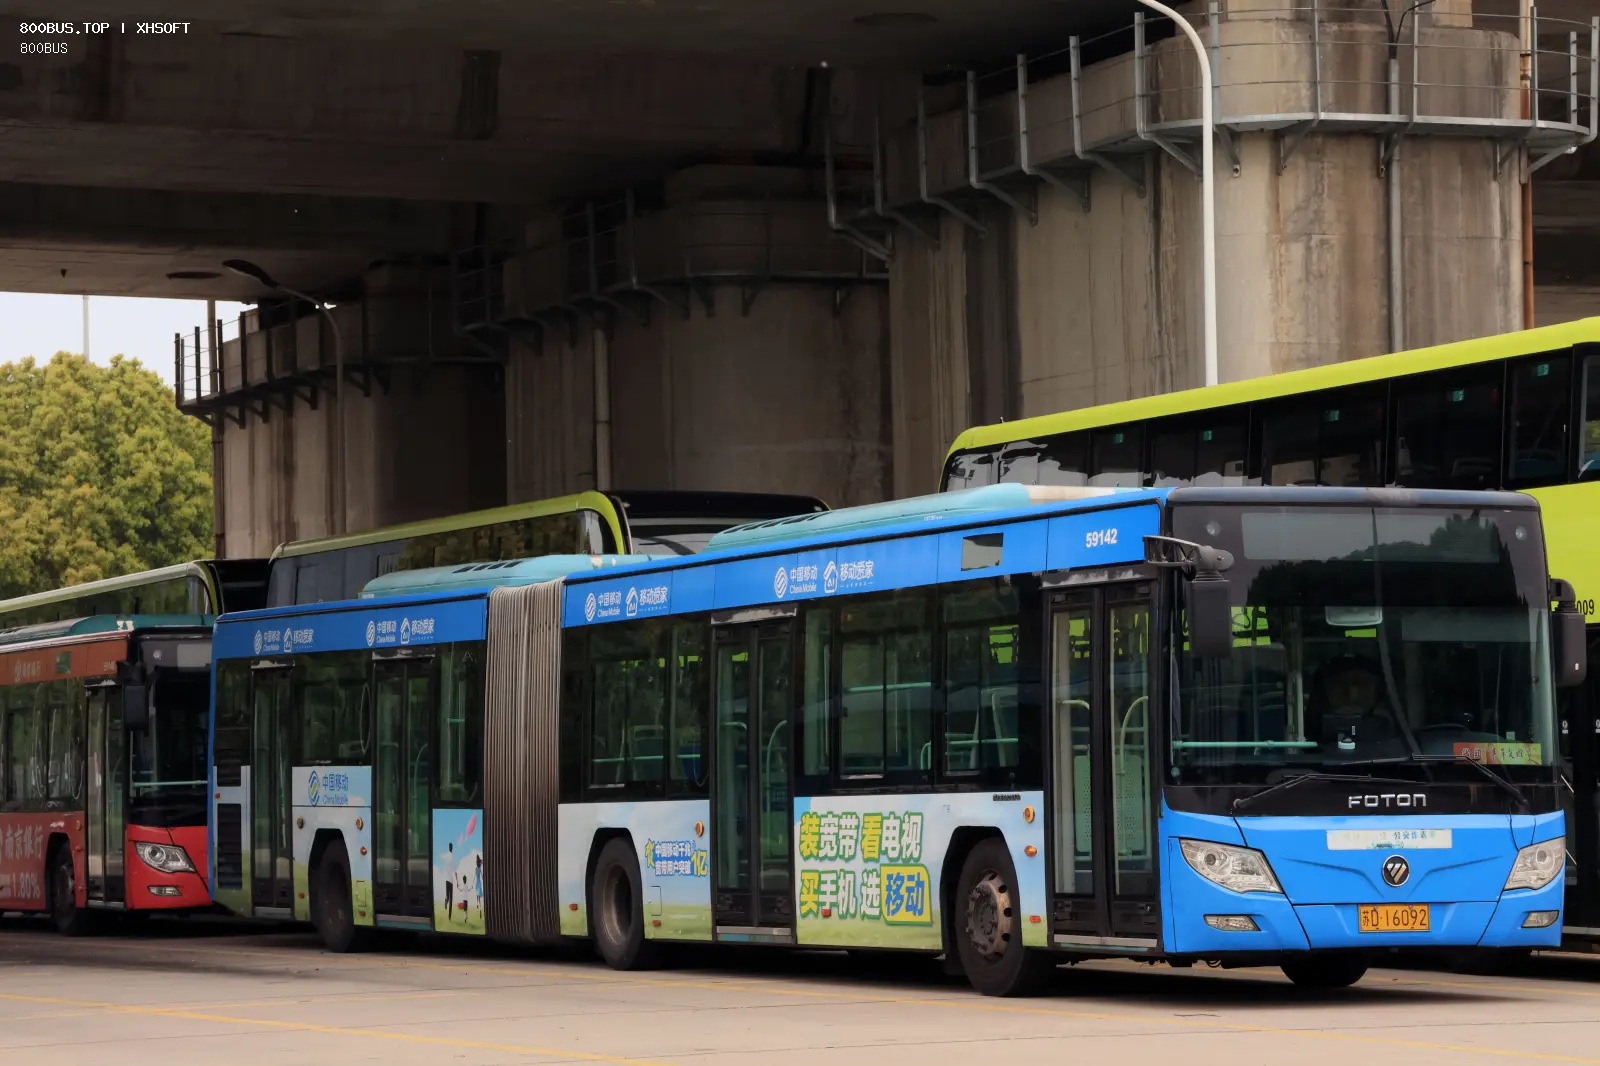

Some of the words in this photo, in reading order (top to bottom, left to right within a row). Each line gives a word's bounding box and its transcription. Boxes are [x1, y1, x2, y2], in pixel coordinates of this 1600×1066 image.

[1085, 528, 1118, 548] 59142
[789, 564, 818, 582] 中国移动
[840, 559, 874, 582] 移动爱家
[639, 586, 668, 606] 移动爱家
[789, 583, 803, 594] China
[803, 582, 817, 592] Mobile
[597, 591, 622, 607] 中国移动
[597, 609, 608, 618] China
[608, 606, 621, 616] Mobile
[376, 620, 397, 634] 中国移动
[322, 773, 349, 791] 中国移动
[1348, 793, 1427, 809] FOTON
